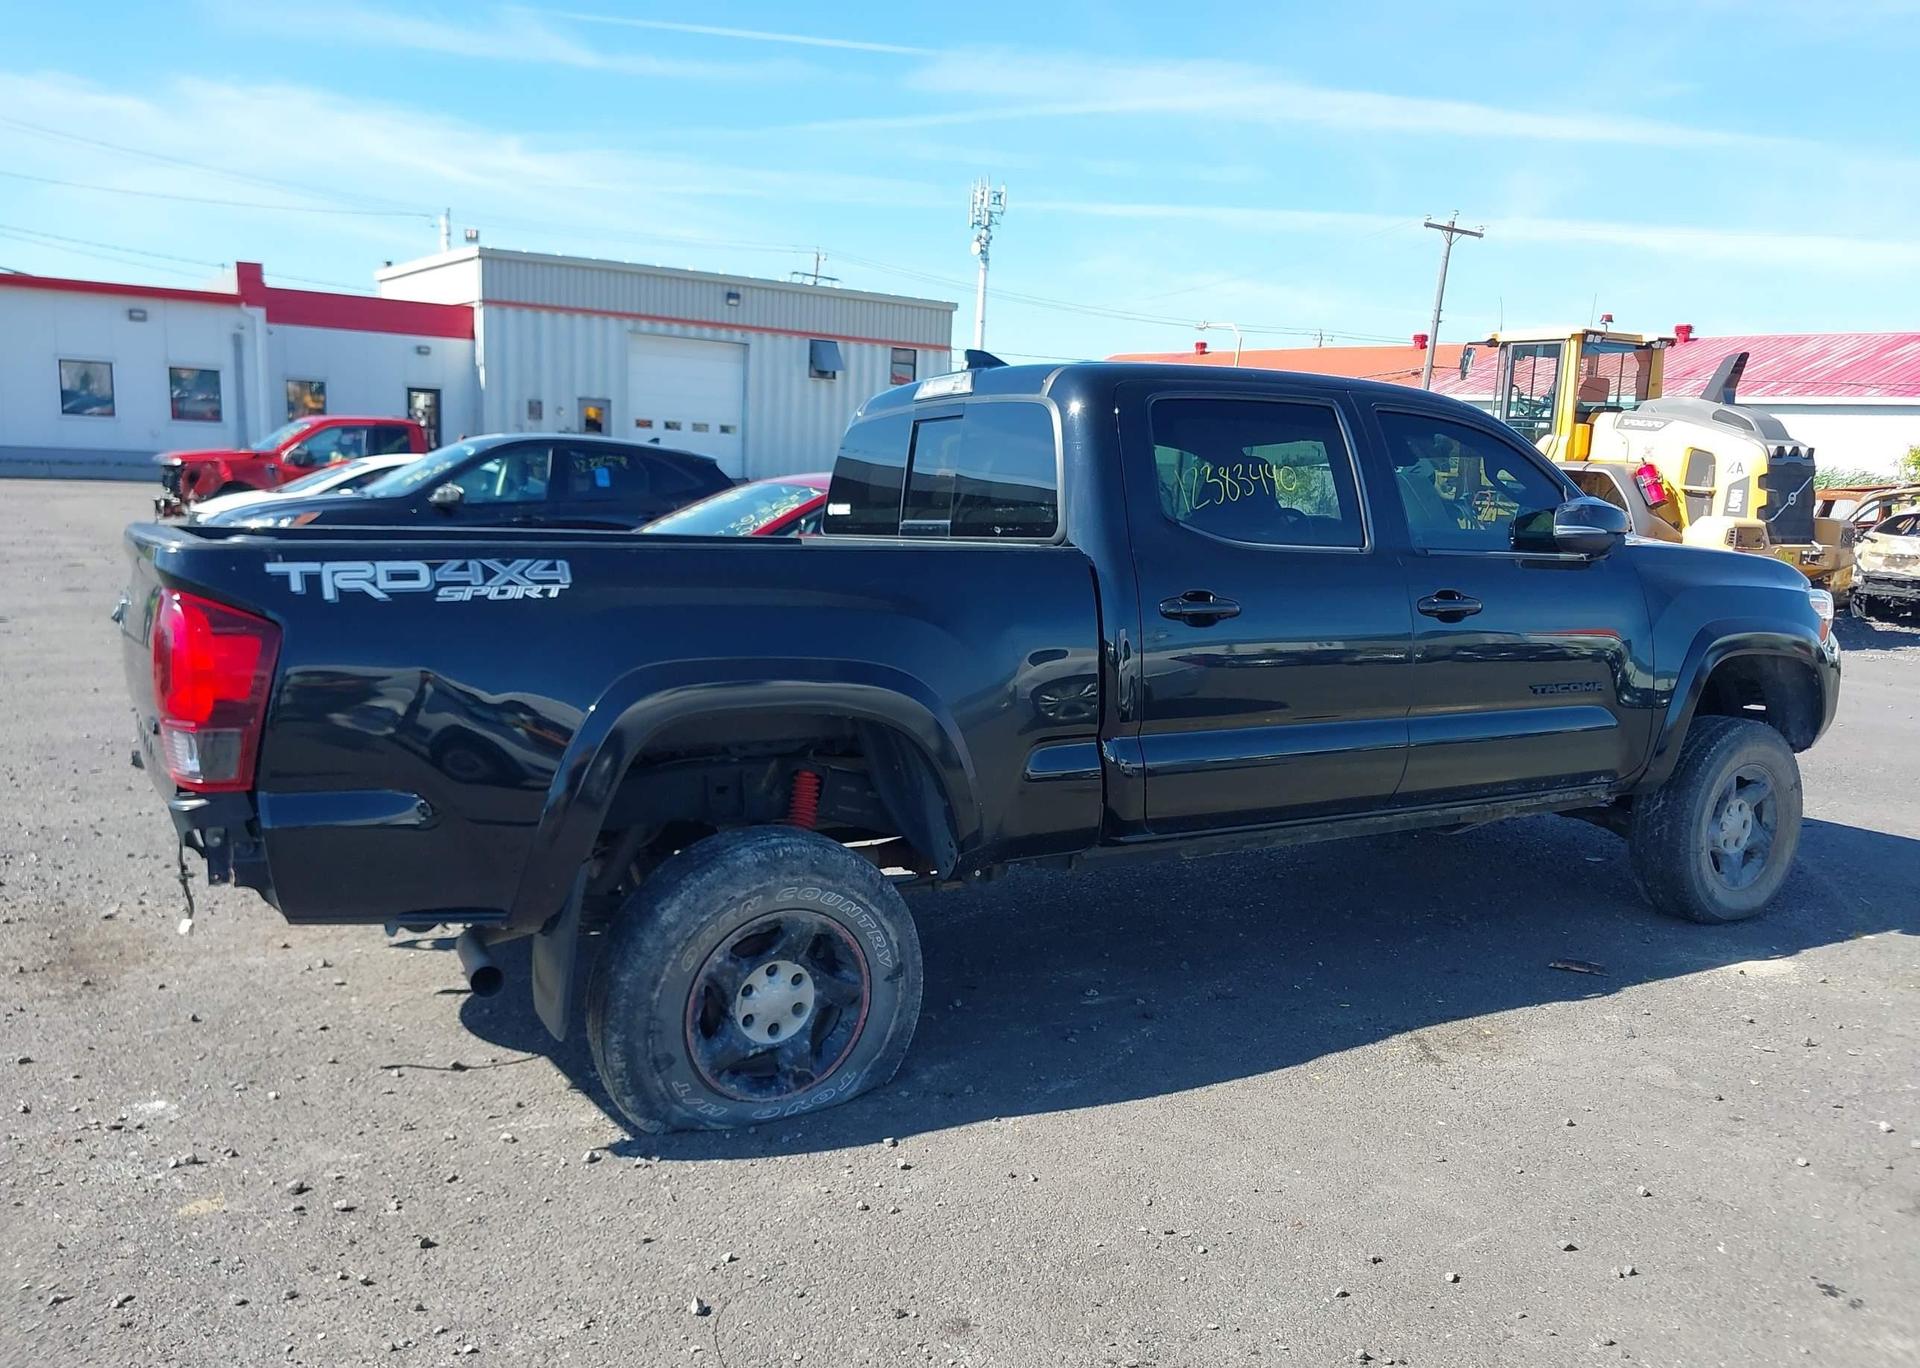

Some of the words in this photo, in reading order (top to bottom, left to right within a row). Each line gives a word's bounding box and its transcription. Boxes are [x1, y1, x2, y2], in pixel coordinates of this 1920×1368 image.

[1623, 418, 1666, 428] VOLVO
[1174, 463, 1297, 513] 12383440
[265, 561, 435, 603] TRD
[435, 584, 571, 602] SPORT
[1529, 681, 1607, 695] TACOMA
[776, 887, 893, 967] COUNTRY
